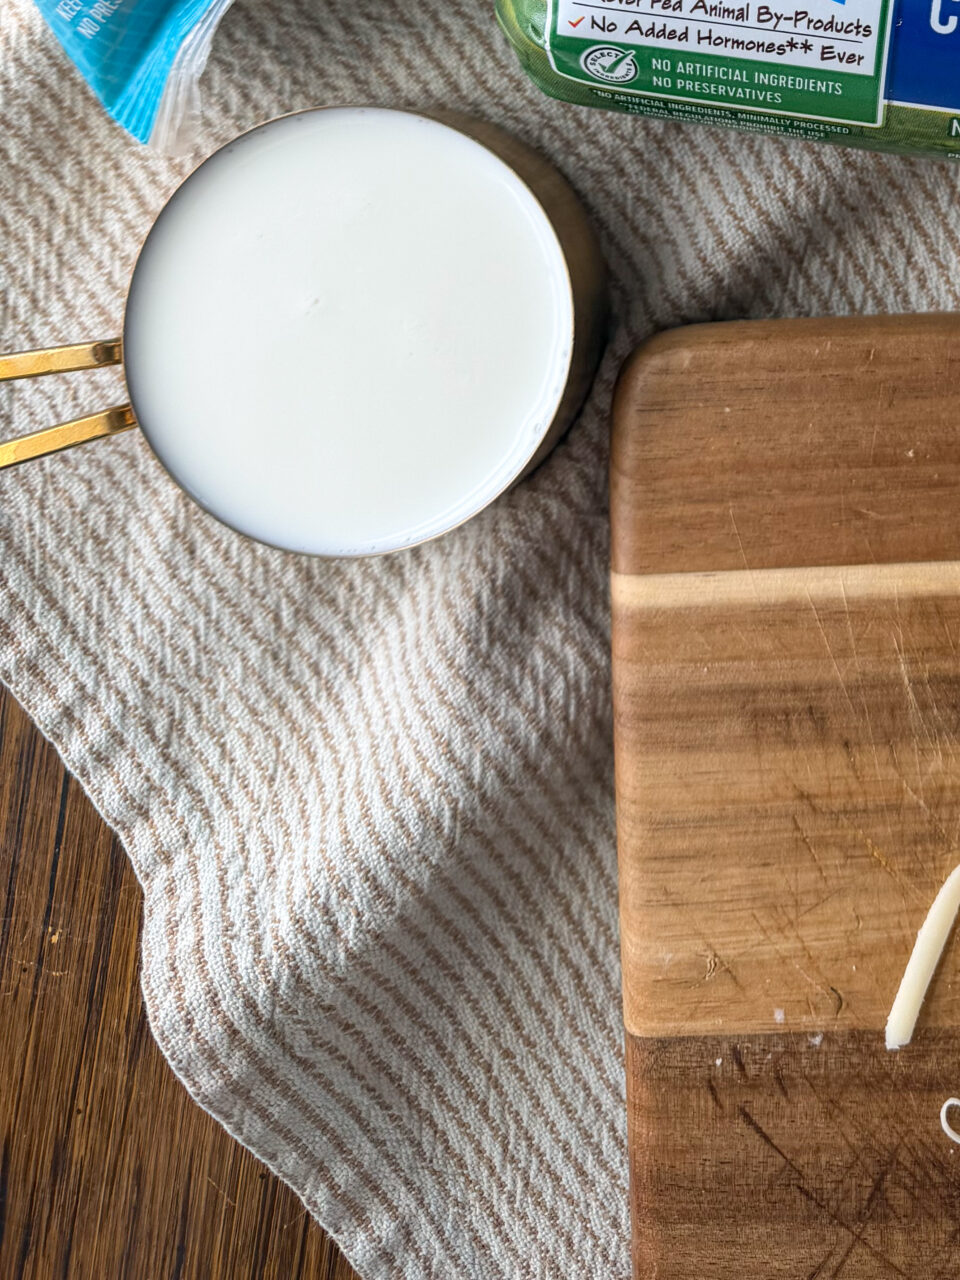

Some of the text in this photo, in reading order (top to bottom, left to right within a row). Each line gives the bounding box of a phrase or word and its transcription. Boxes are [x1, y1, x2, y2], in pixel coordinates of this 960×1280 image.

[76, 17, 101, 40] NO
[756, 5, 873, 38] By-Products
[591, 15, 618, 33] No
[625, 19, 689, 42] Added
[820, 45, 865, 66] Ever
[589, 51, 620, 66] SELECT
[651, 58, 843, 95] NO ARTIFICIAL INGREDIENTS
[652, 76, 782, 103] NO PRESERVATIVES
[614, 94, 667, 108] ARTIFICIAL
[737, 112, 791, 126] MINIMALLY
[793, 120, 850, 134] PROCESSED
